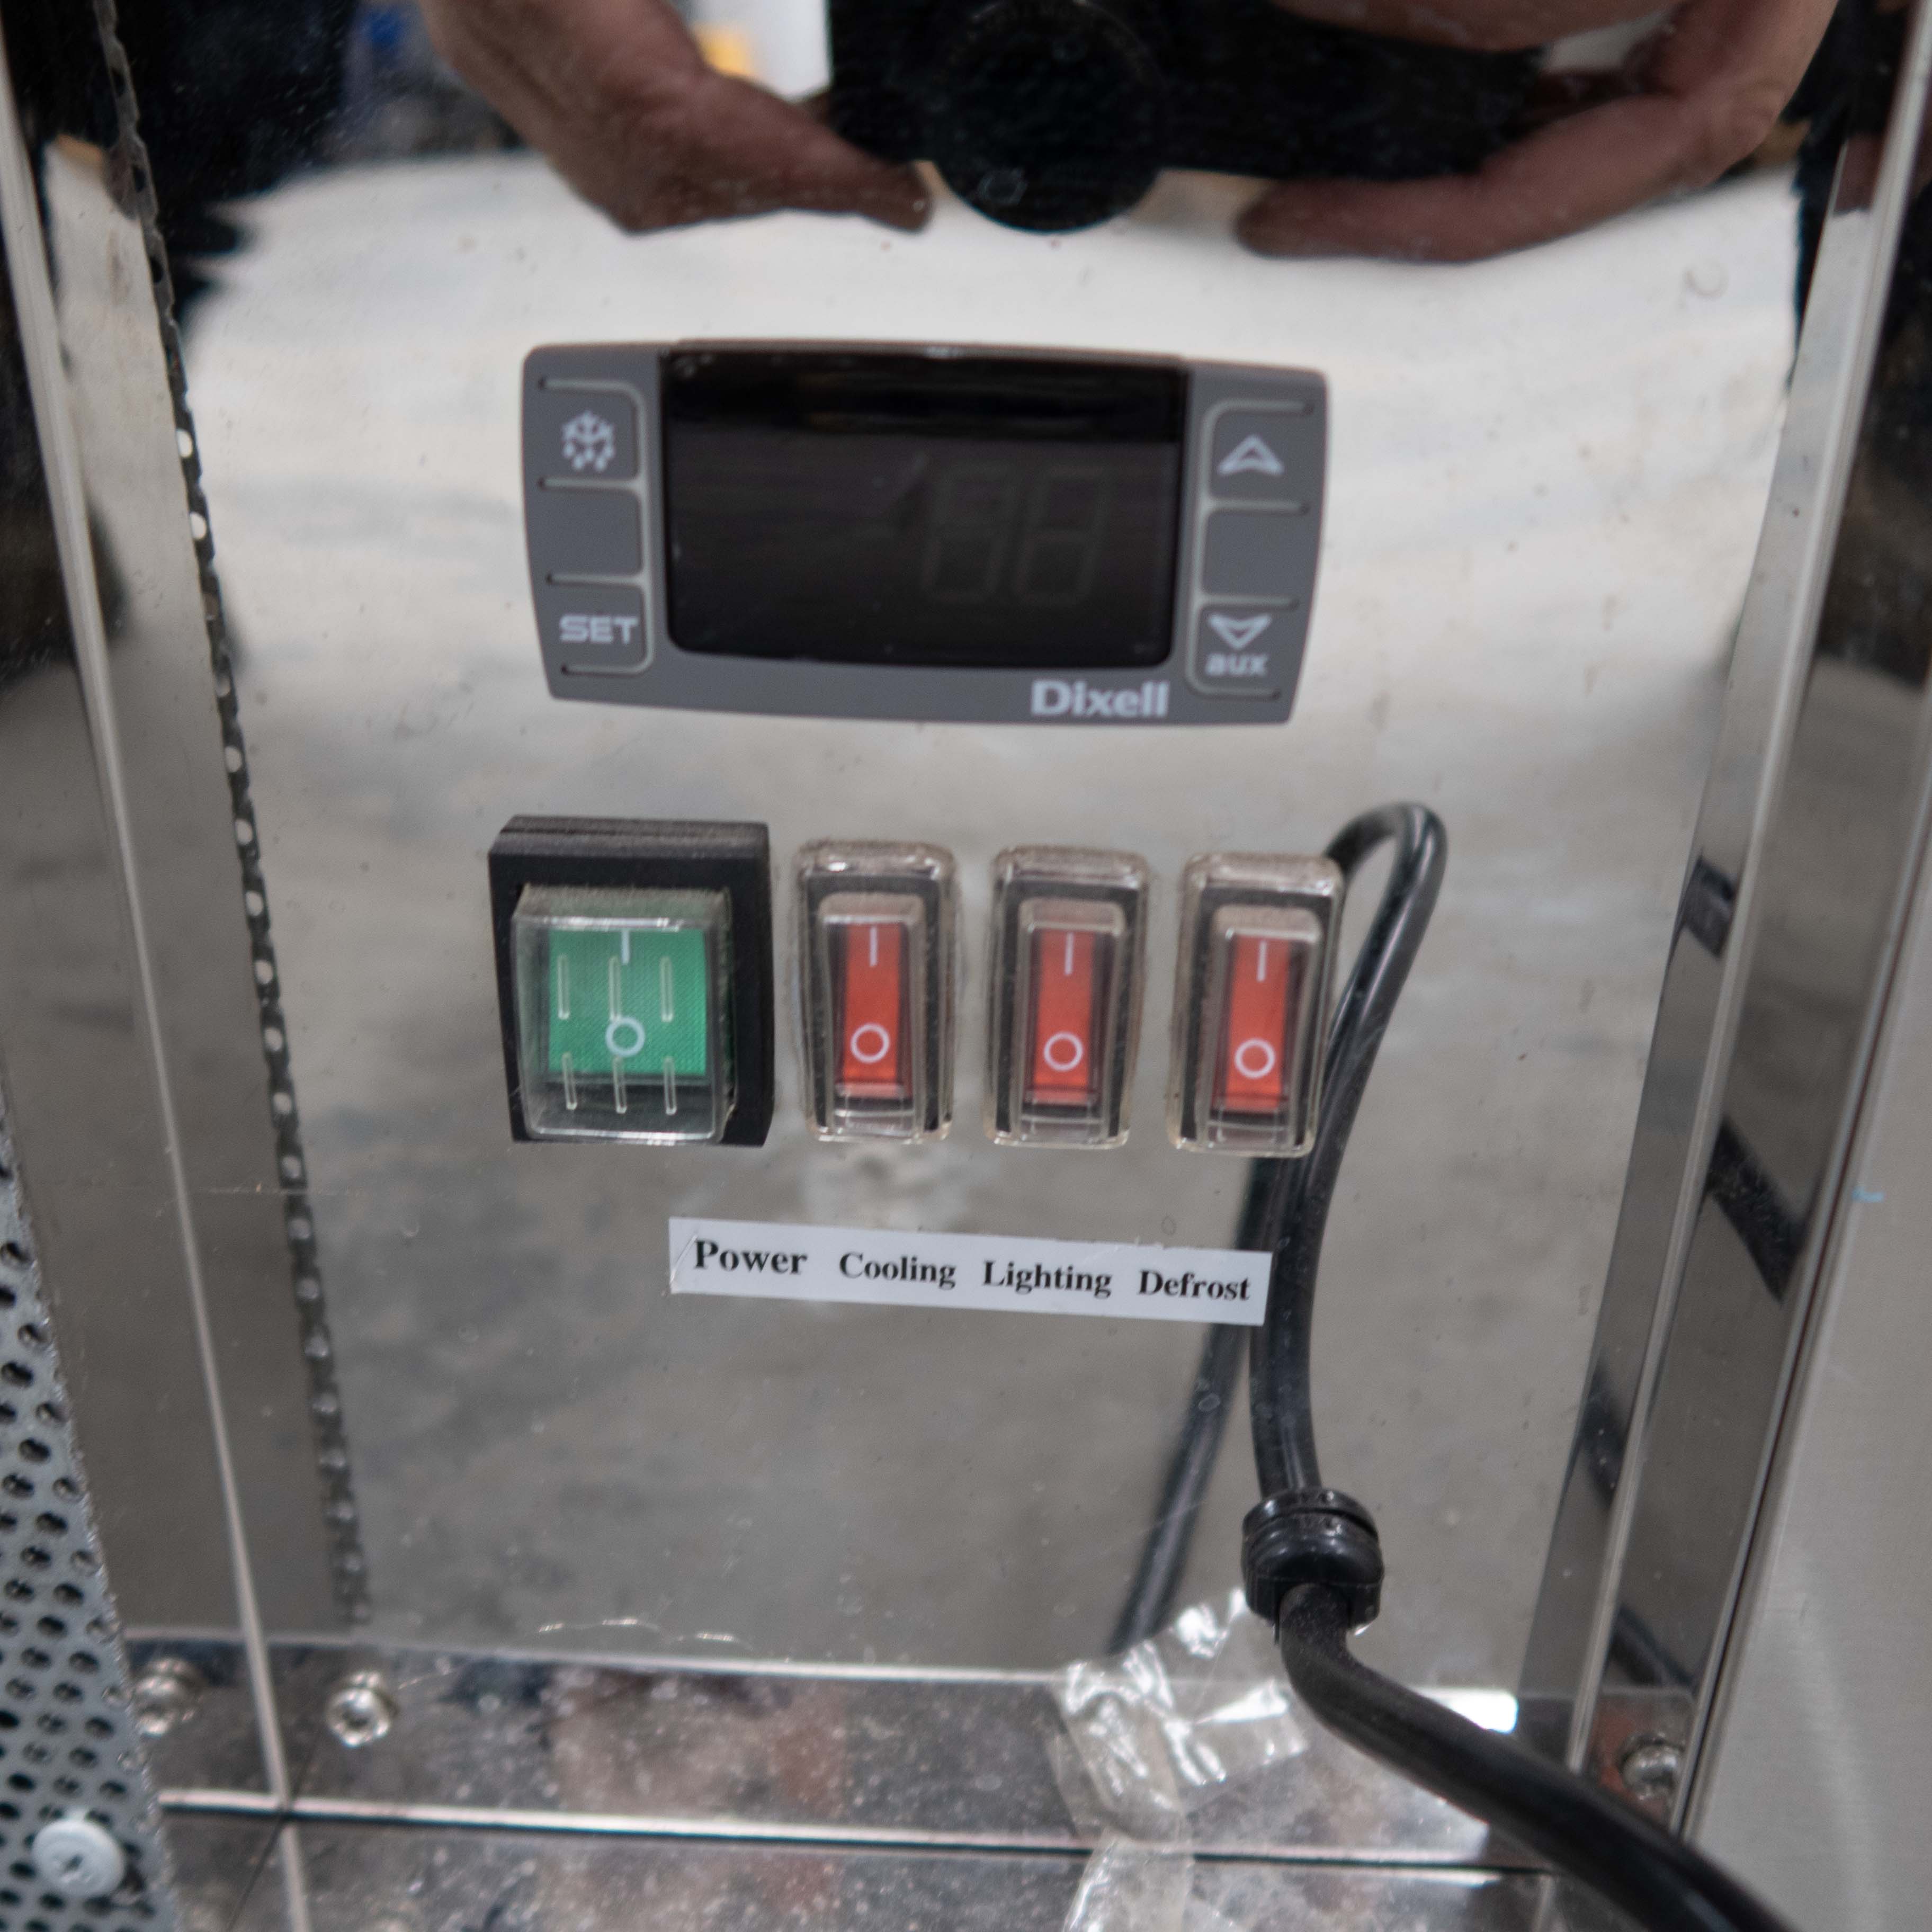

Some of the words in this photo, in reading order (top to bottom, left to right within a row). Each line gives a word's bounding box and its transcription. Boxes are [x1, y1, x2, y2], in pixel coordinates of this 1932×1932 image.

[560, 614, 639, 645] SET
[1205, 652, 1269, 677] aux
[1031, 678, 1170, 718] Dixell
[694, 1239, 808, 1276] Power
[839, 1251, 957, 1291] Cooling
[982, 1259, 1112, 1299] Lighting
[1138, 1269, 1251, 1301] Defrost
